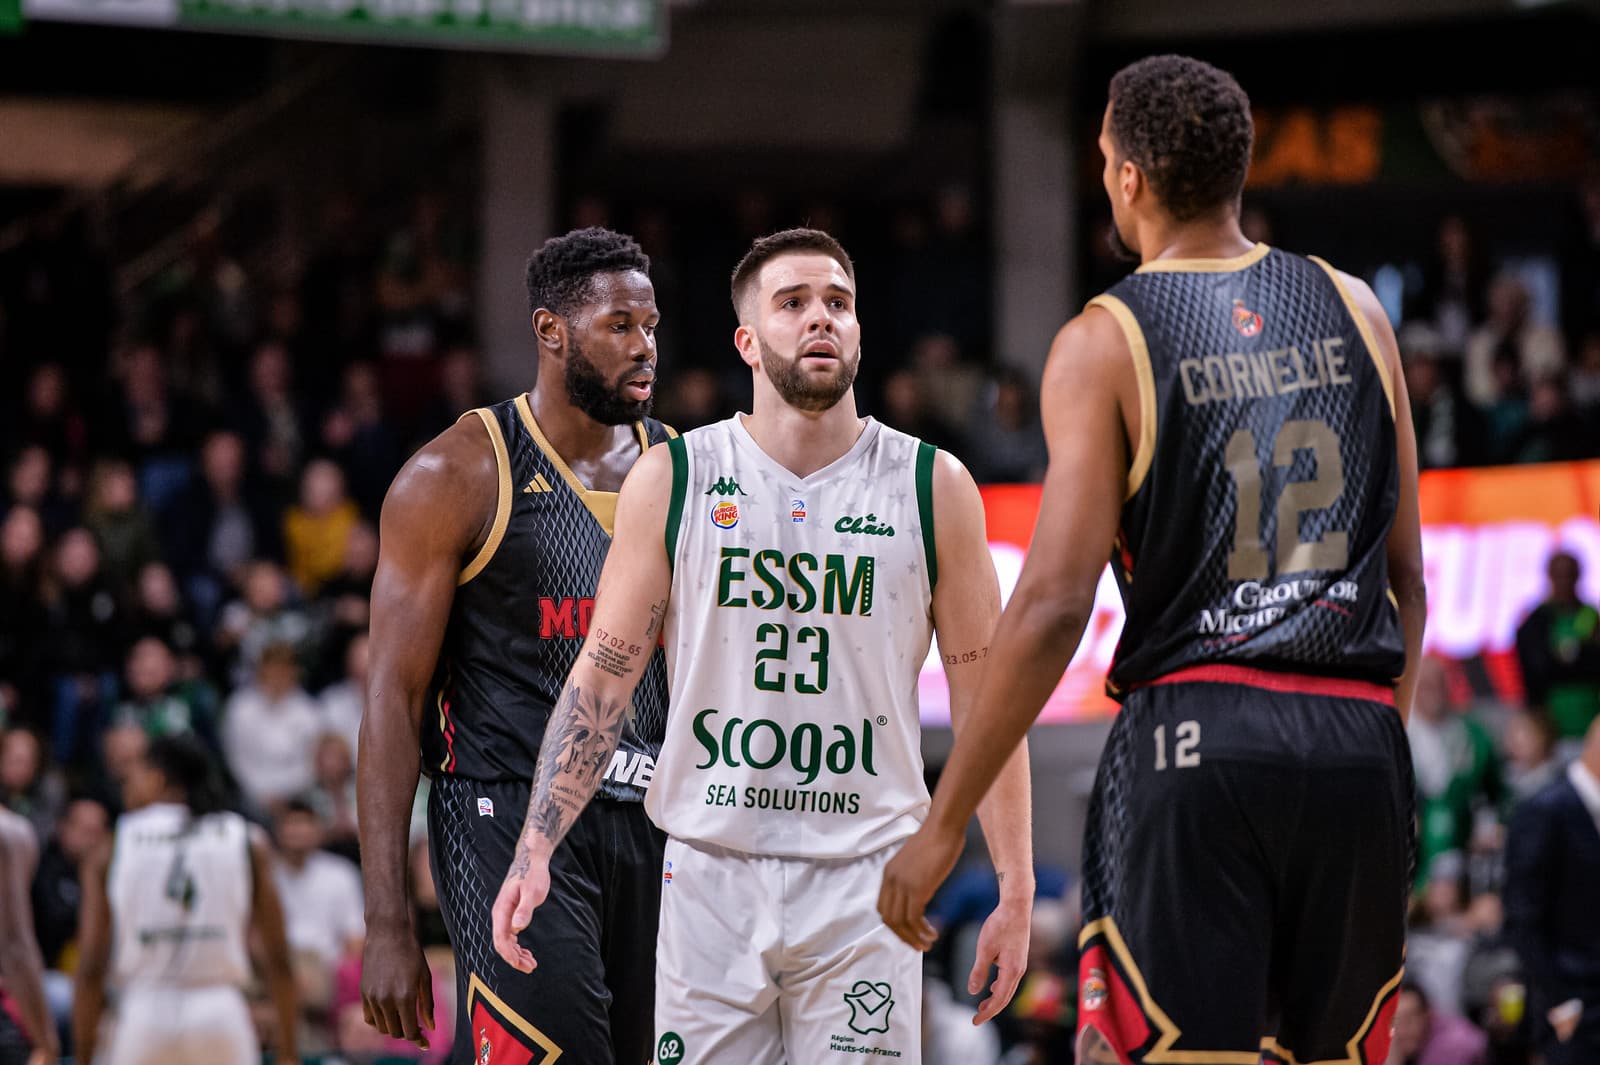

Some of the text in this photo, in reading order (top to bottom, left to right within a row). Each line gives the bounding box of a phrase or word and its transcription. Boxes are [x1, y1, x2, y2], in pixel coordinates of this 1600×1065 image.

[1180, 336, 1352, 405] CORNELIE
[1225, 420, 1349, 580] 12
[715, 510, 738, 523] KING
[718, 547, 875, 616] ESSM
[1199, 607, 1286, 634] MICHE
[754, 623, 829, 694] 23
[945, 647, 988, 664] 23.05.7
[1154, 720, 1201, 771] 12
[705, 784, 860, 814] SEA SOLUTIONS
[659, 1039, 680, 1060] 62
[830, 1043, 901, 1057] Hauts-de-France
[831, 1034, 855, 1042] Région
